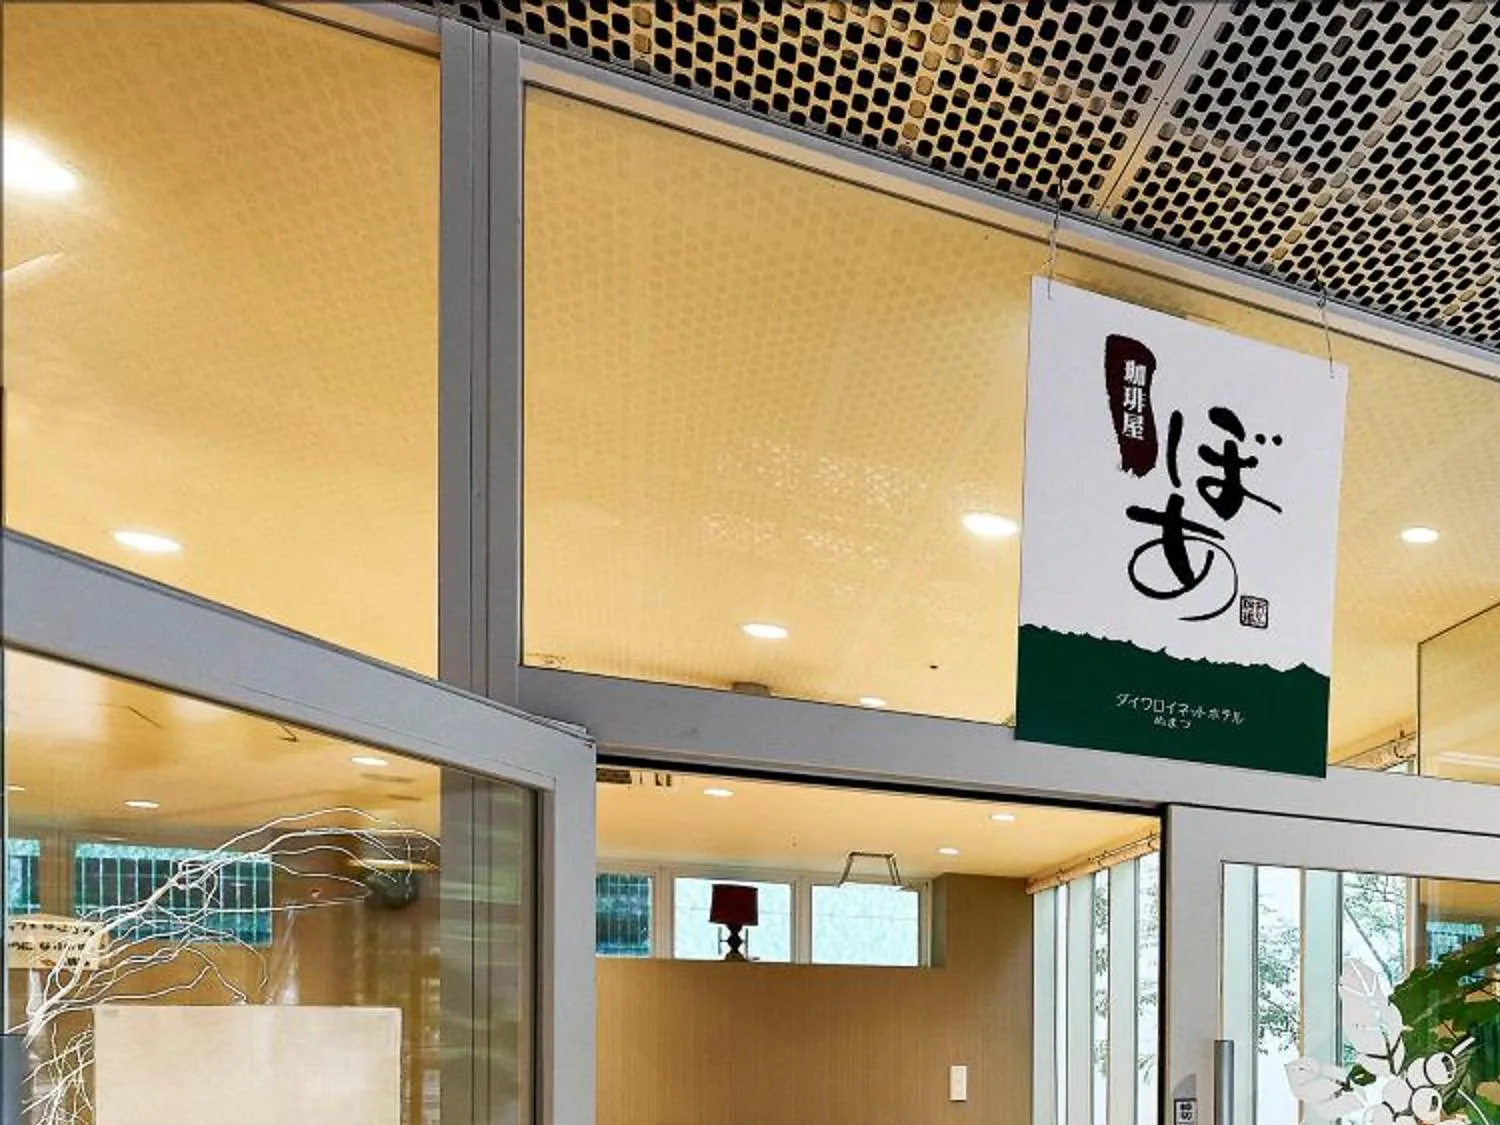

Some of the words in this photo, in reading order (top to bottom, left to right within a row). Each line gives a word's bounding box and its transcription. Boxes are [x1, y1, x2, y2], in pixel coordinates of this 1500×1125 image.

[1116, 693, 1245, 725] ダイワロイネットホテル
[1153, 715, 1193, 729] ぬまつ
